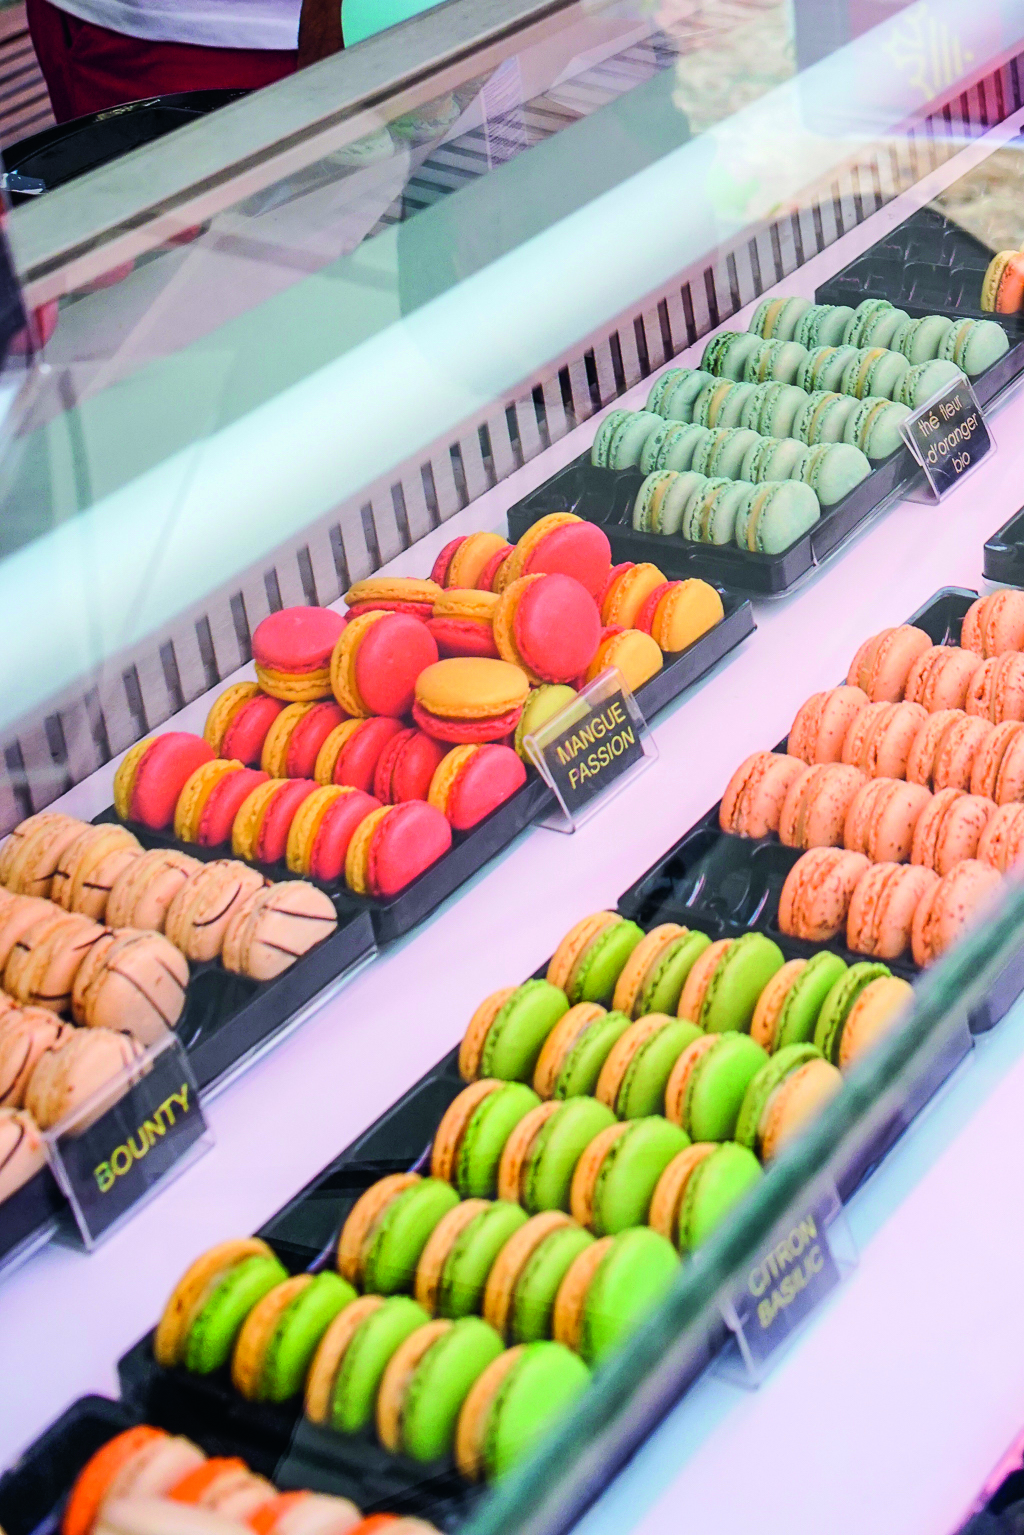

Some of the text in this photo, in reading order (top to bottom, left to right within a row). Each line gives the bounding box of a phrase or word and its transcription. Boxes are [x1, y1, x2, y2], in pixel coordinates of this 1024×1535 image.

[918, 395, 963, 437] thé fleur
[927, 413, 979, 464] d'oranger
[952, 451, 970, 474] bio
[556, 702, 626, 765] MANGUE
[568, 726, 636, 790] PASSION
[93, 1083, 189, 1193] BOUNTY
[749, 1214, 818, 1298] CITRON
[757, 1245, 824, 1329] BASILIC
